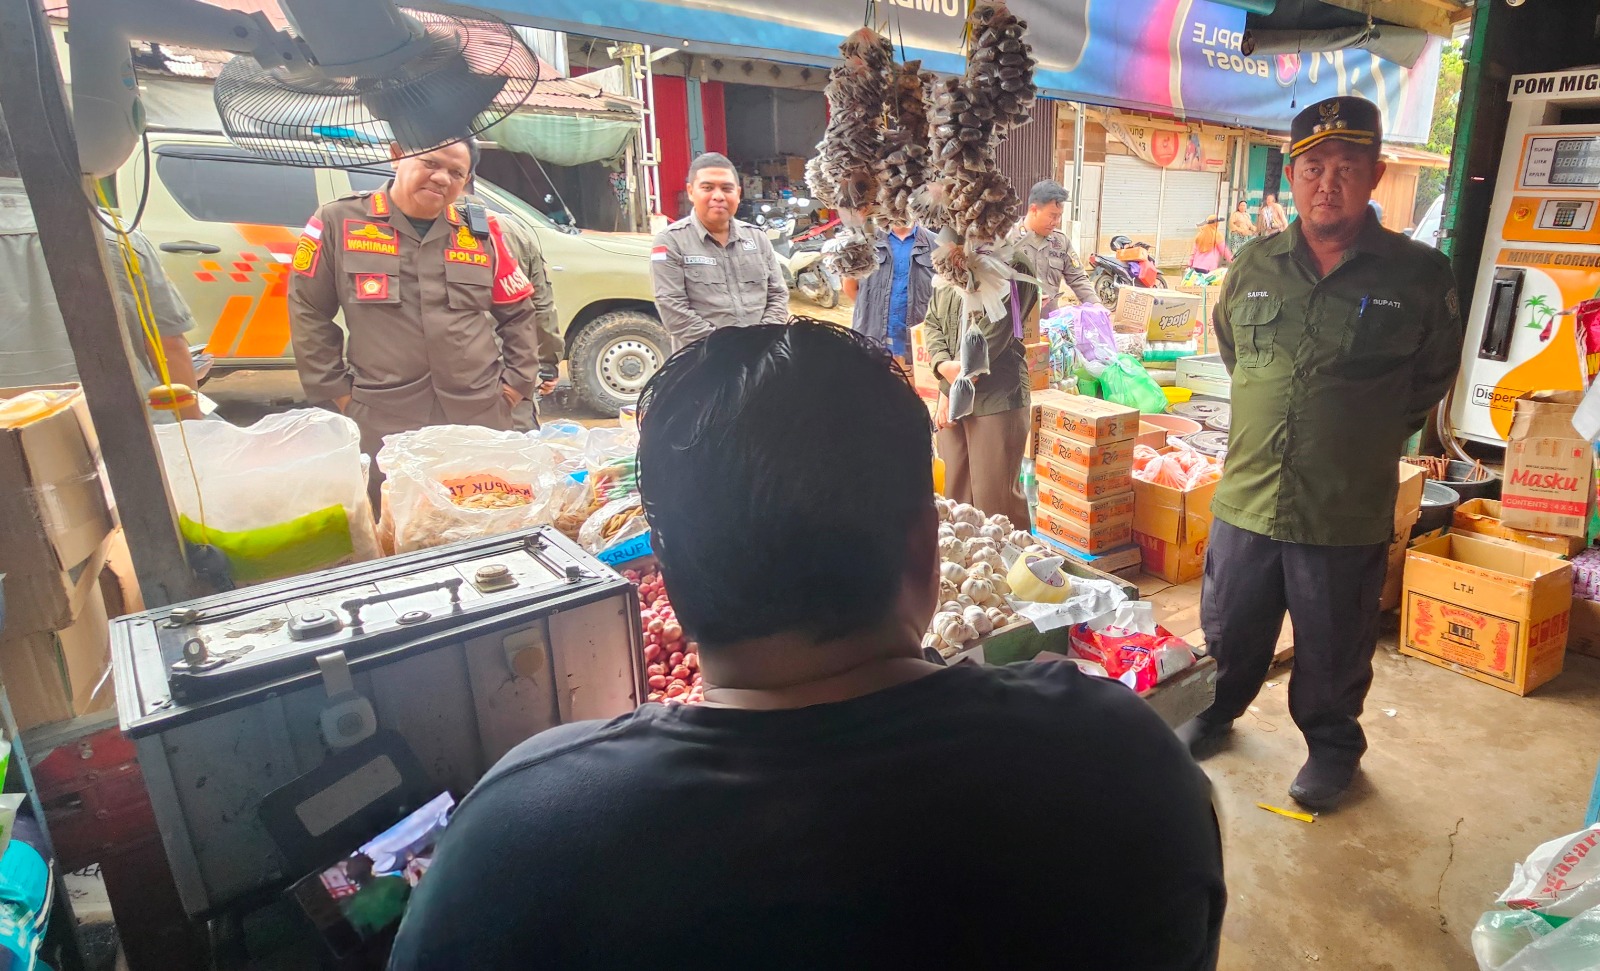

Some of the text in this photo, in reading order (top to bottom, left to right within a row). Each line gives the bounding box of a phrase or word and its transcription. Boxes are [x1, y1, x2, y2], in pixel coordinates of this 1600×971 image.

[1512, 73, 1600, 95] POM MIG
[347, 239, 395, 253] WAHIMAN
[449, 251, 487, 264] POL PP
[1506, 251, 1600, 267] MINYAK GORENG
[1372, 298, 1401, 309] BUPATI
[1158, 309, 1191, 330] Black
[1476, 388, 1516, 403] Disper
[1062, 416, 1077, 432] Rio
[1058, 444, 1072, 460] Rio
[1049, 467, 1062, 482] Rio
[1509, 468, 1578, 492] Masku
[1051, 494, 1064, 510] Rio
[1506, 498, 1549, 510] CONTENTS
[1050, 521, 1064, 536] Rio
[1194, 540, 1204, 556] G
